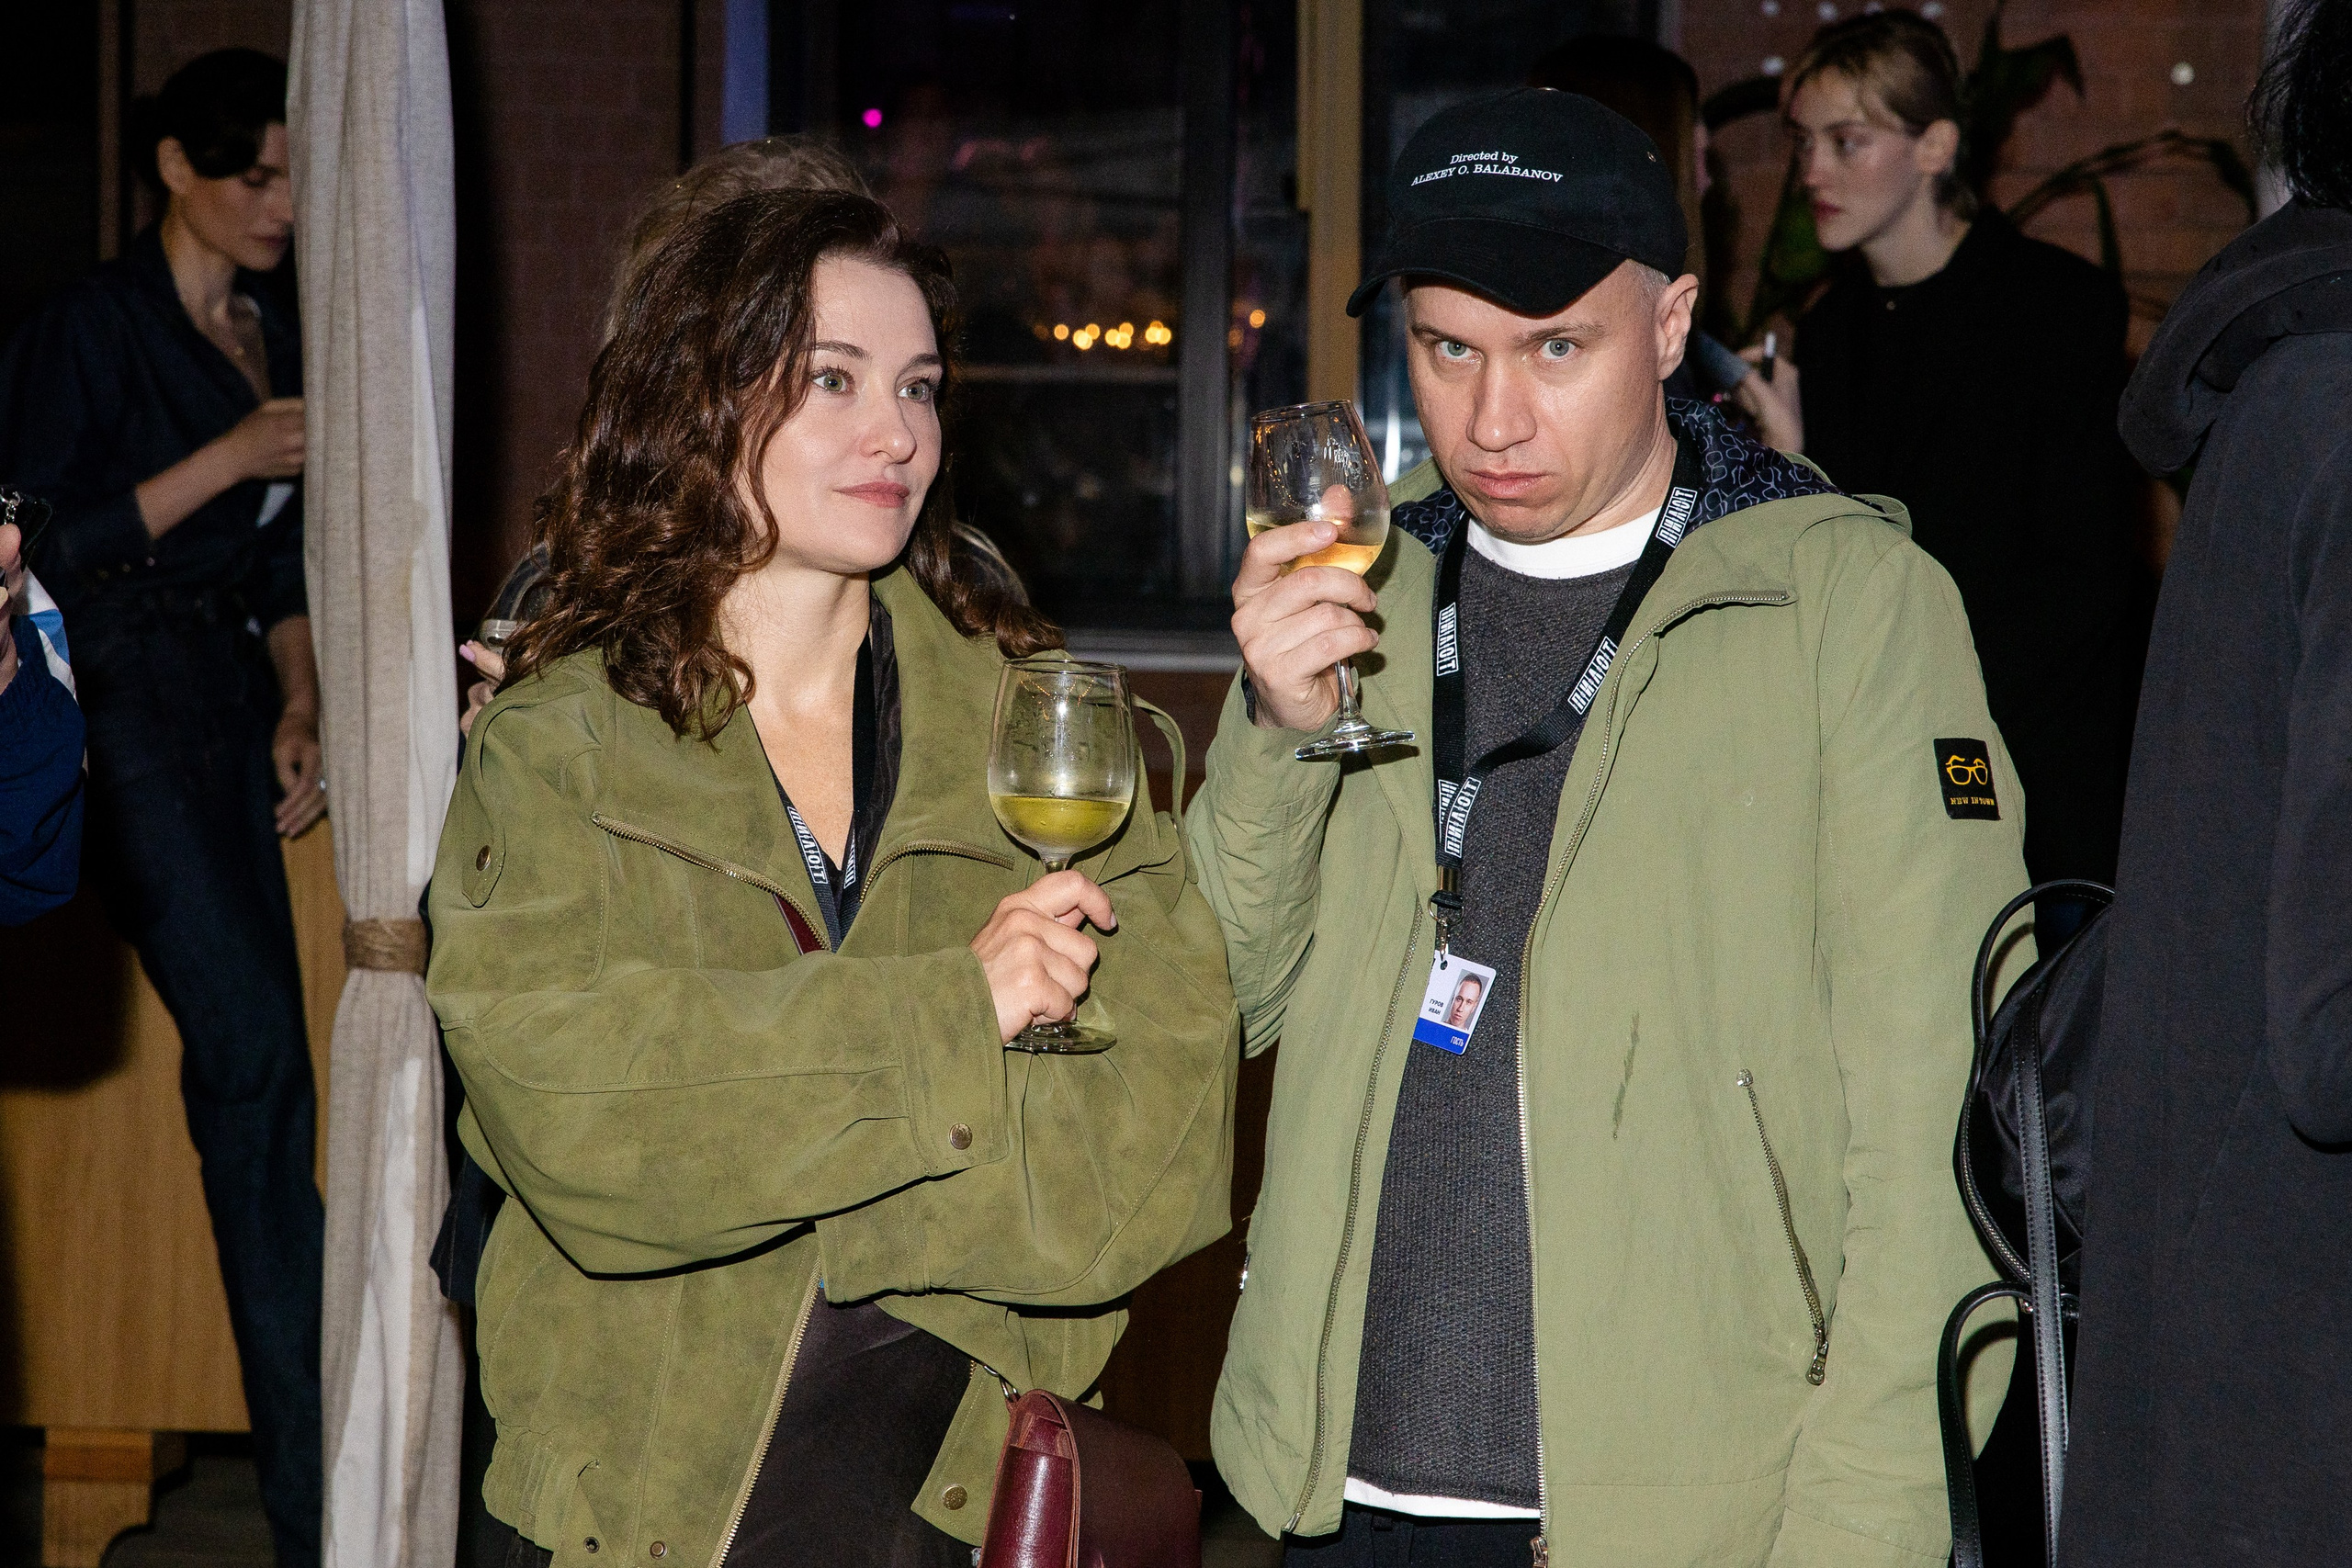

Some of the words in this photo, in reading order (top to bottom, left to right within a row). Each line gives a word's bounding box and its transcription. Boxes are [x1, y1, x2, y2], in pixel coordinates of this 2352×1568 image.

[1449, 151, 1499, 165] Directed
[1501, 152, 1520, 164] by
[1410, 166, 1457, 186] ALEXEY
[1457, 165, 1470, 175] O.
[1472, 164, 1564, 183] BALABANOV
[1657, 489, 1695, 546] ПИЛОТ
[1438, 605, 1457, 671] ПИЛОТ
[1570, 639, 1617, 711] ПИЛОТ
[1950, 796, 1969, 806] NEW
[1445, 780, 1477, 855] ПИЛОТ
[1428, 1007, 1442, 1015] ИВАН
[1429, 998, 1444, 1008] ГУРОВ
[1450, 1035, 1464, 1047] ГОСТЬ
